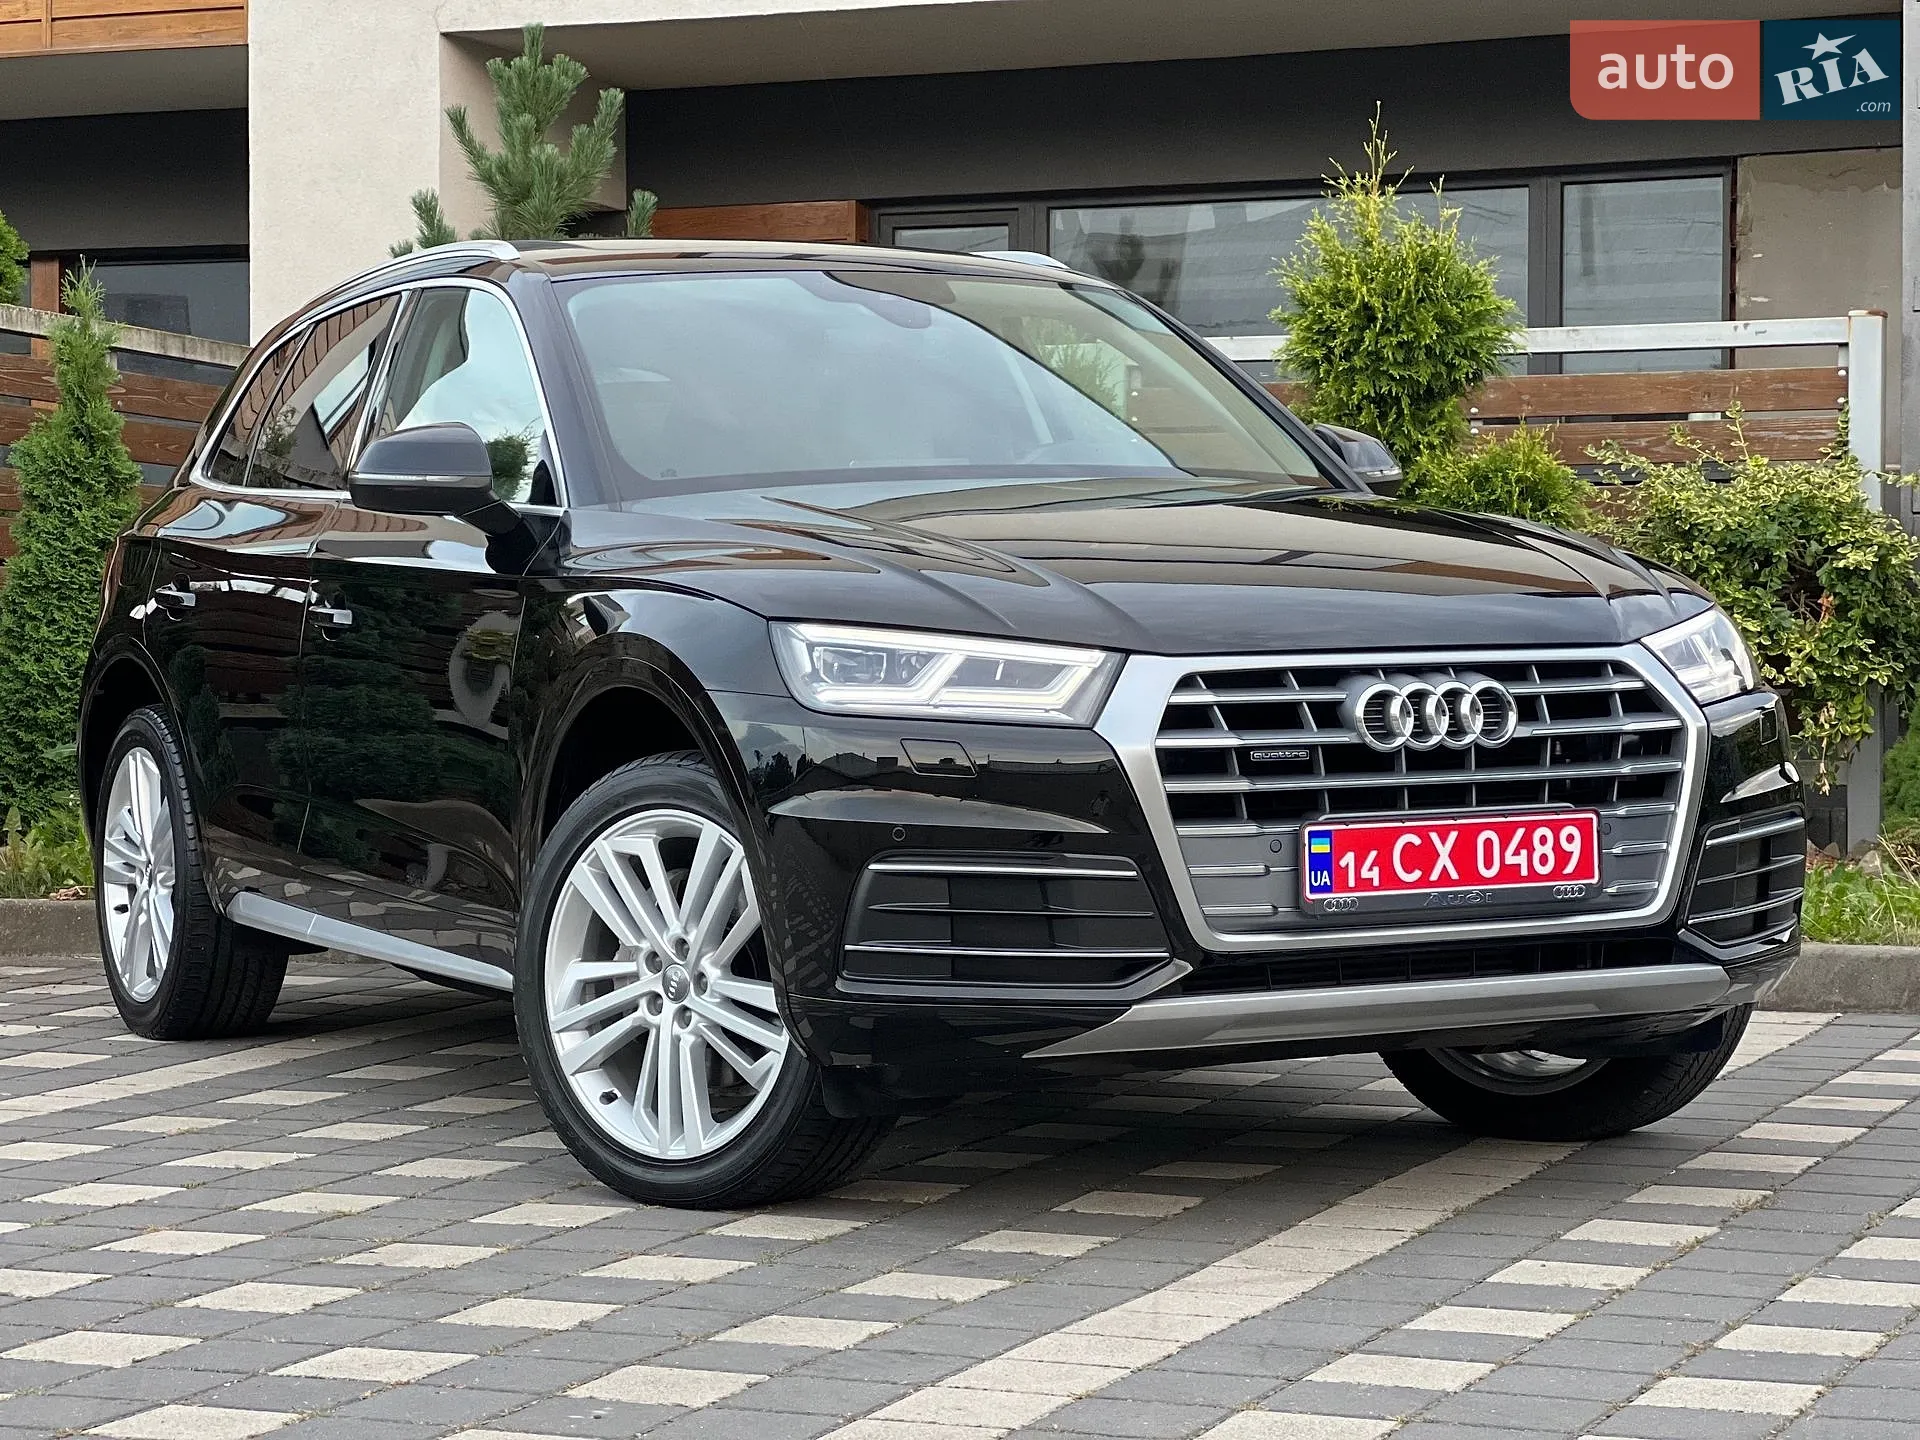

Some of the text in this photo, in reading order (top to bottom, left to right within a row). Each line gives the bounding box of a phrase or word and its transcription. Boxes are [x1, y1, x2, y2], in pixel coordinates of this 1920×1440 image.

[1253, 751, 1307, 760] quattro
[1338, 825, 1582, 888] 14 CX 0489
[1310, 870, 1331, 886] UA
